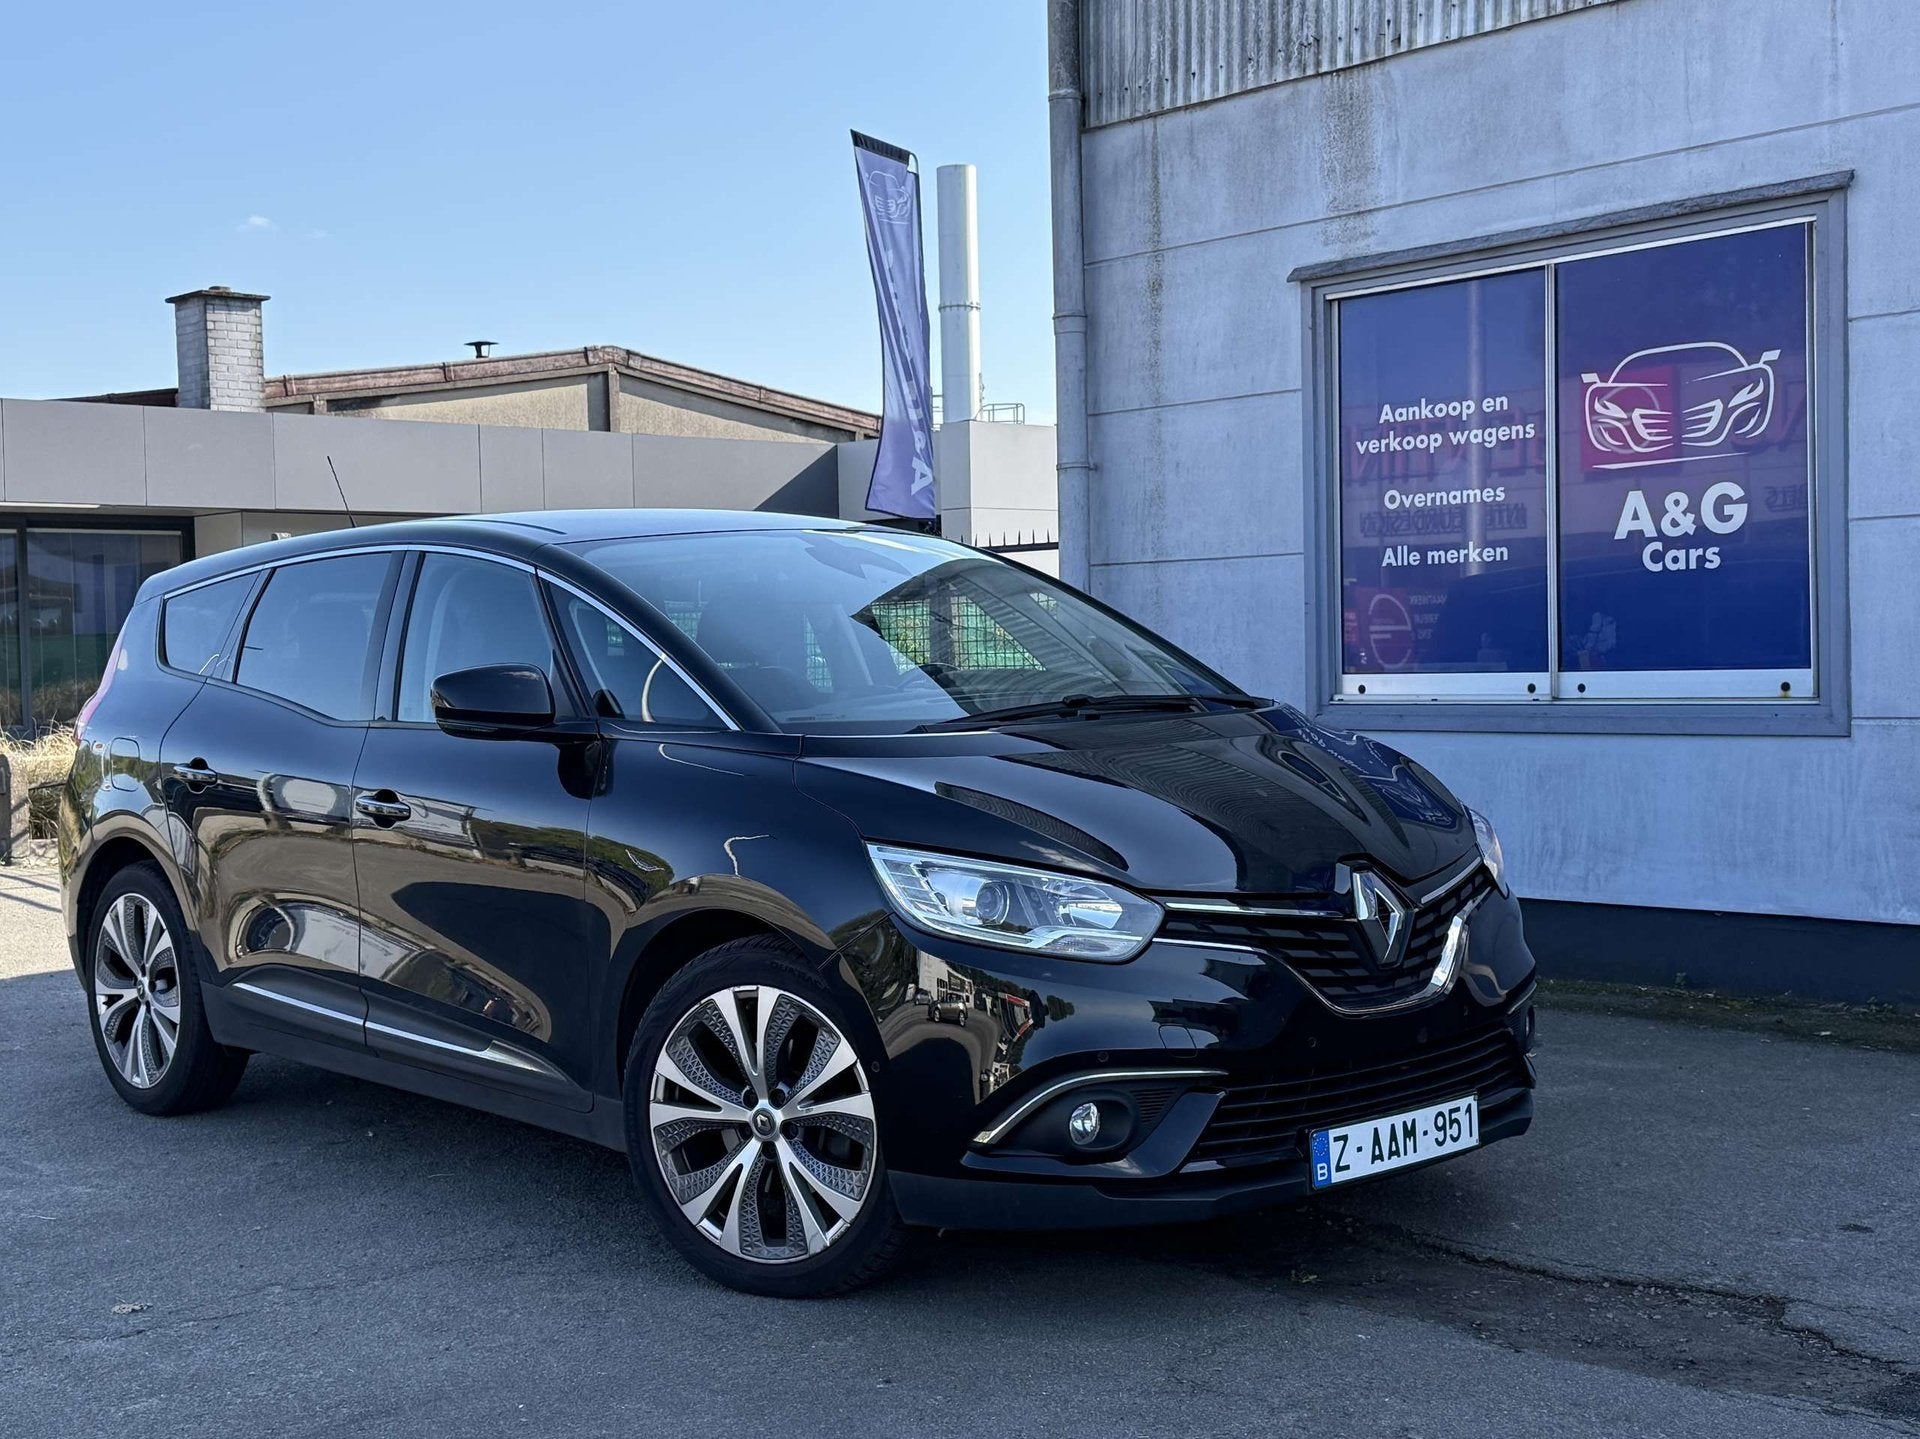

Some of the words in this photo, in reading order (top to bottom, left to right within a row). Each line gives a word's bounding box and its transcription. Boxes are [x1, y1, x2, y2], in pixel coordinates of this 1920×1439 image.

[1379, 398, 1475, 424] Aankoop
[1482, 396, 1508, 412] en
[1356, 431, 1442, 454] verkoop
[1449, 421, 1535, 448] wagens
[1384, 486, 1505, 510] Overnames
[1614, 482, 1748, 540] A&G
[1382, 545, 1420, 567] Alle
[1427, 541, 1508, 566] merken
[1642, 541, 1721, 572] Cars
[1317, 1163, 1328, 1181] B
